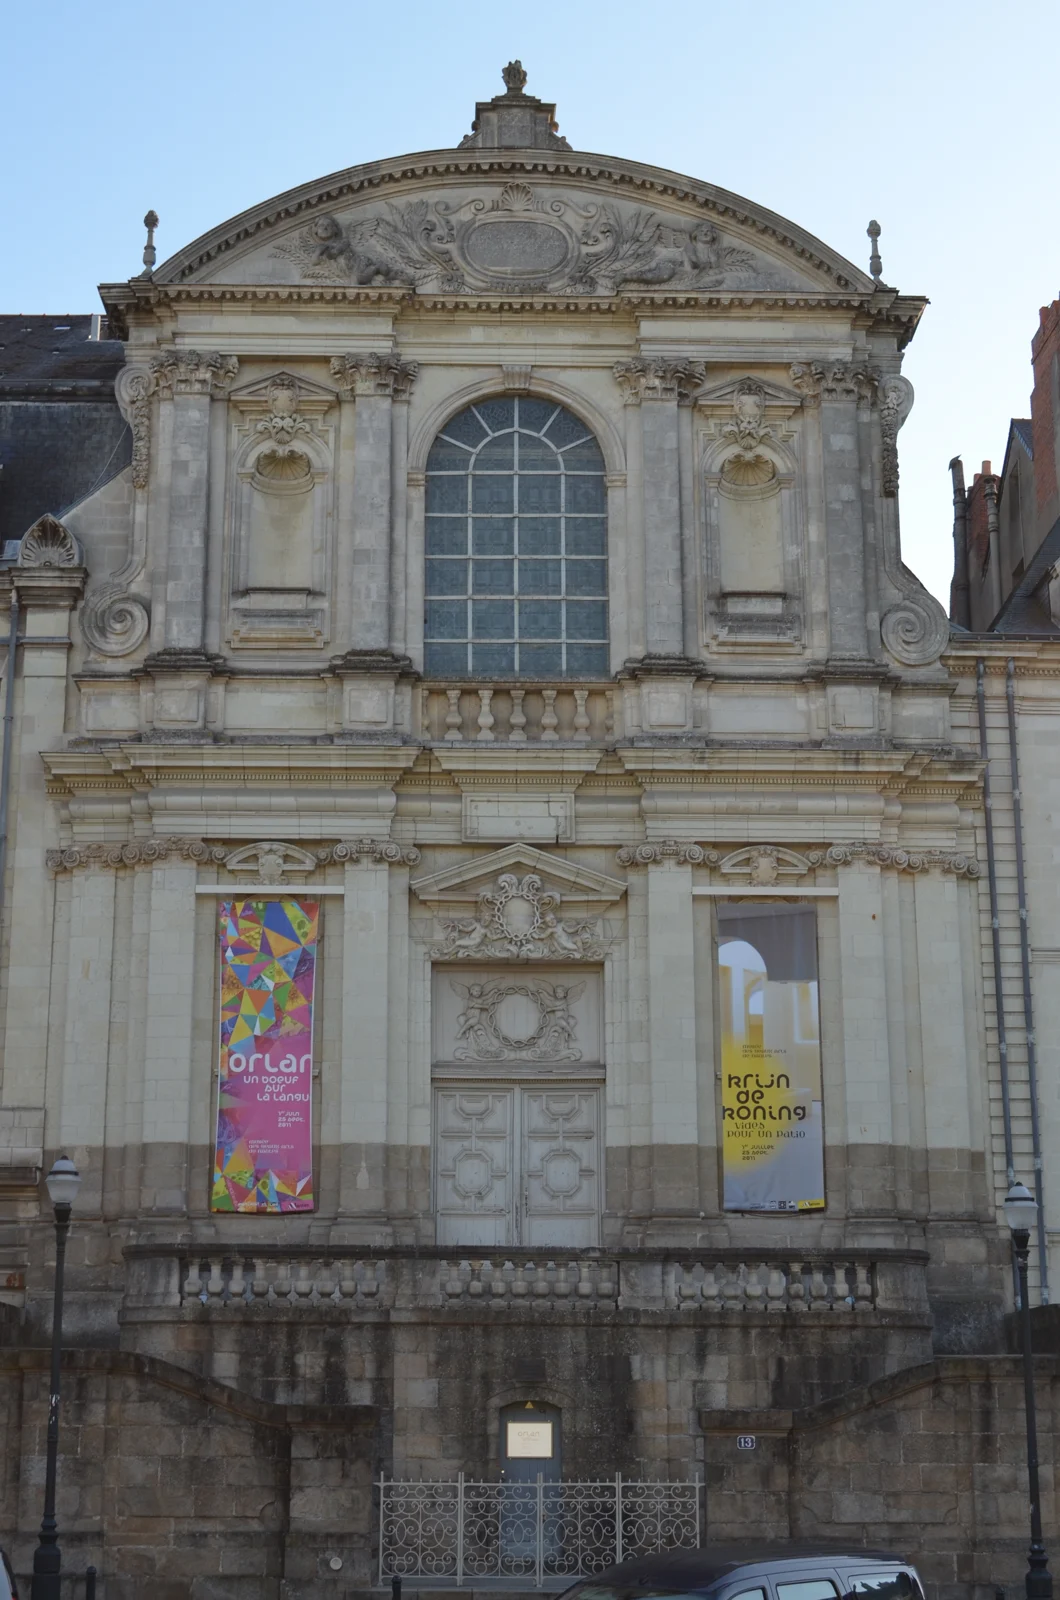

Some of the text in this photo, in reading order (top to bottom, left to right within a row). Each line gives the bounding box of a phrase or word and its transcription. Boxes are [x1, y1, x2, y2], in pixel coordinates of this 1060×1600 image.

[728, 1074, 790, 1088] krijn
[257, 1093, 270, 1101] la
[736, 1090, 764, 1104] de
[722, 1106, 806, 1120] koning
[740, 1438, 752, 1448] 13
